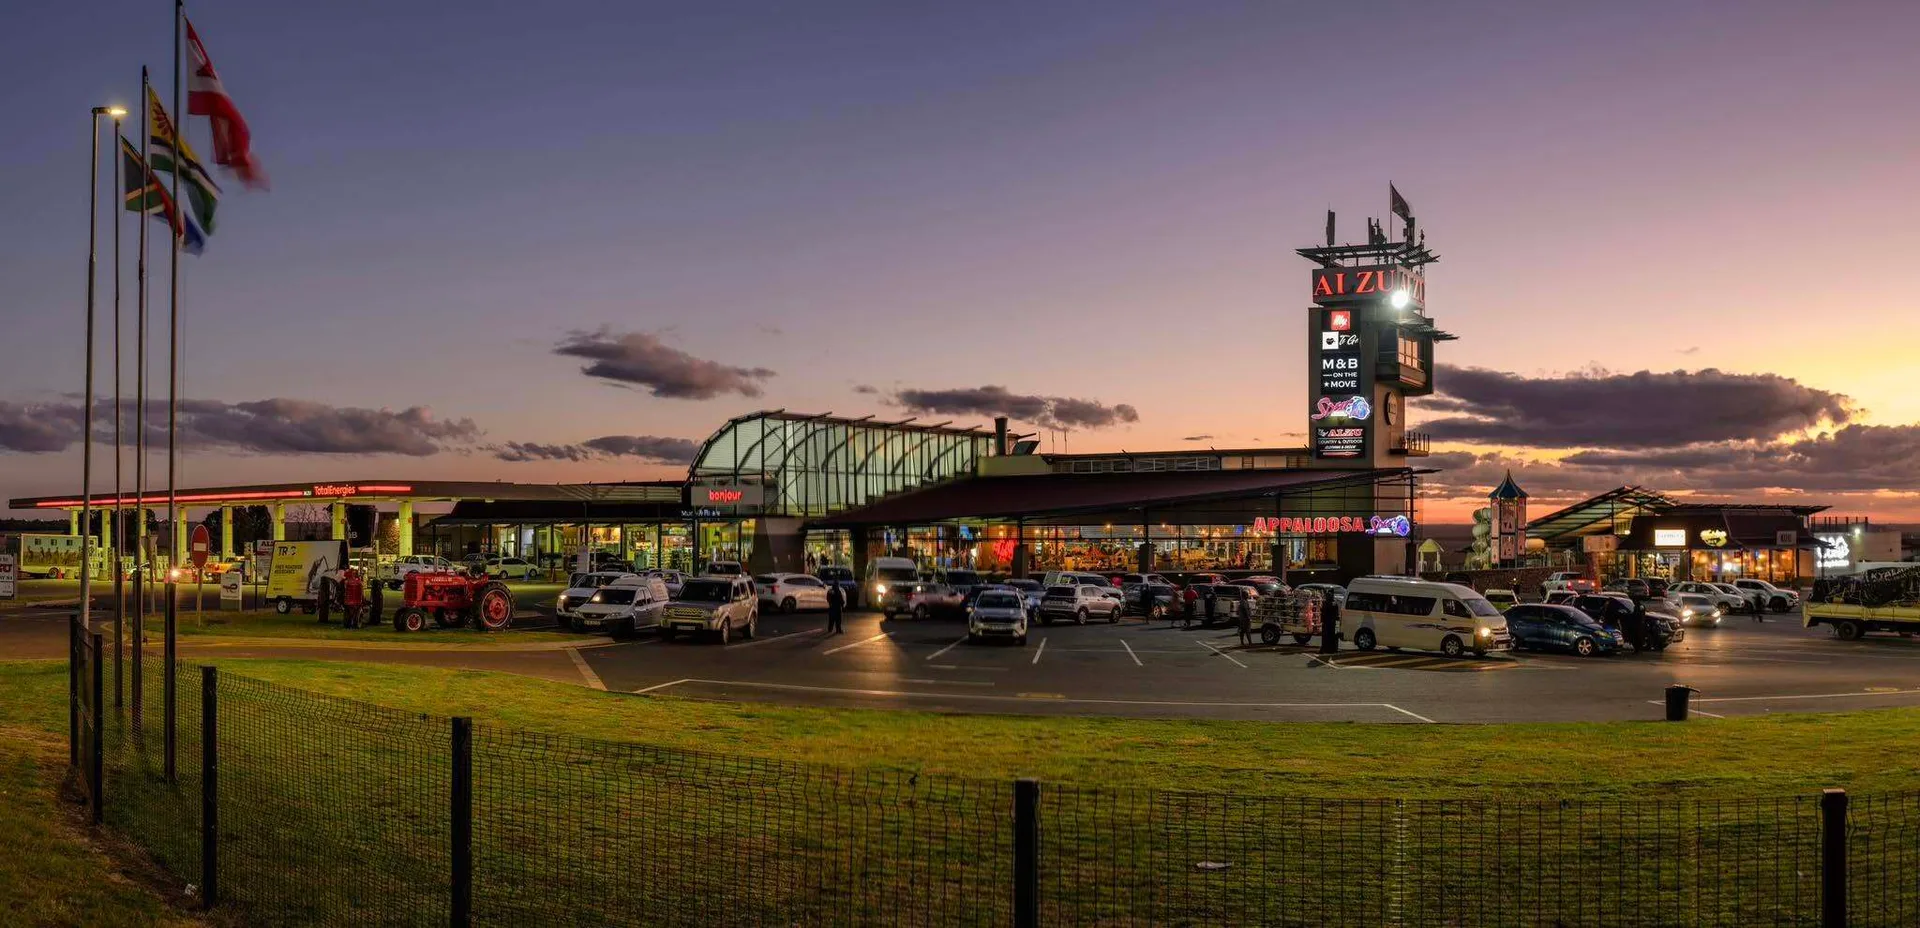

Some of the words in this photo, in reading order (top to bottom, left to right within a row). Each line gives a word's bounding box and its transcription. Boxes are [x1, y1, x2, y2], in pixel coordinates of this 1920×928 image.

[1330, 380, 1357, 388] MOVE
[313, 484, 356, 497] TotalEnergies
[709, 490, 742, 502] bonjour
[1253, 516, 1365, 533] APPALOOSA
